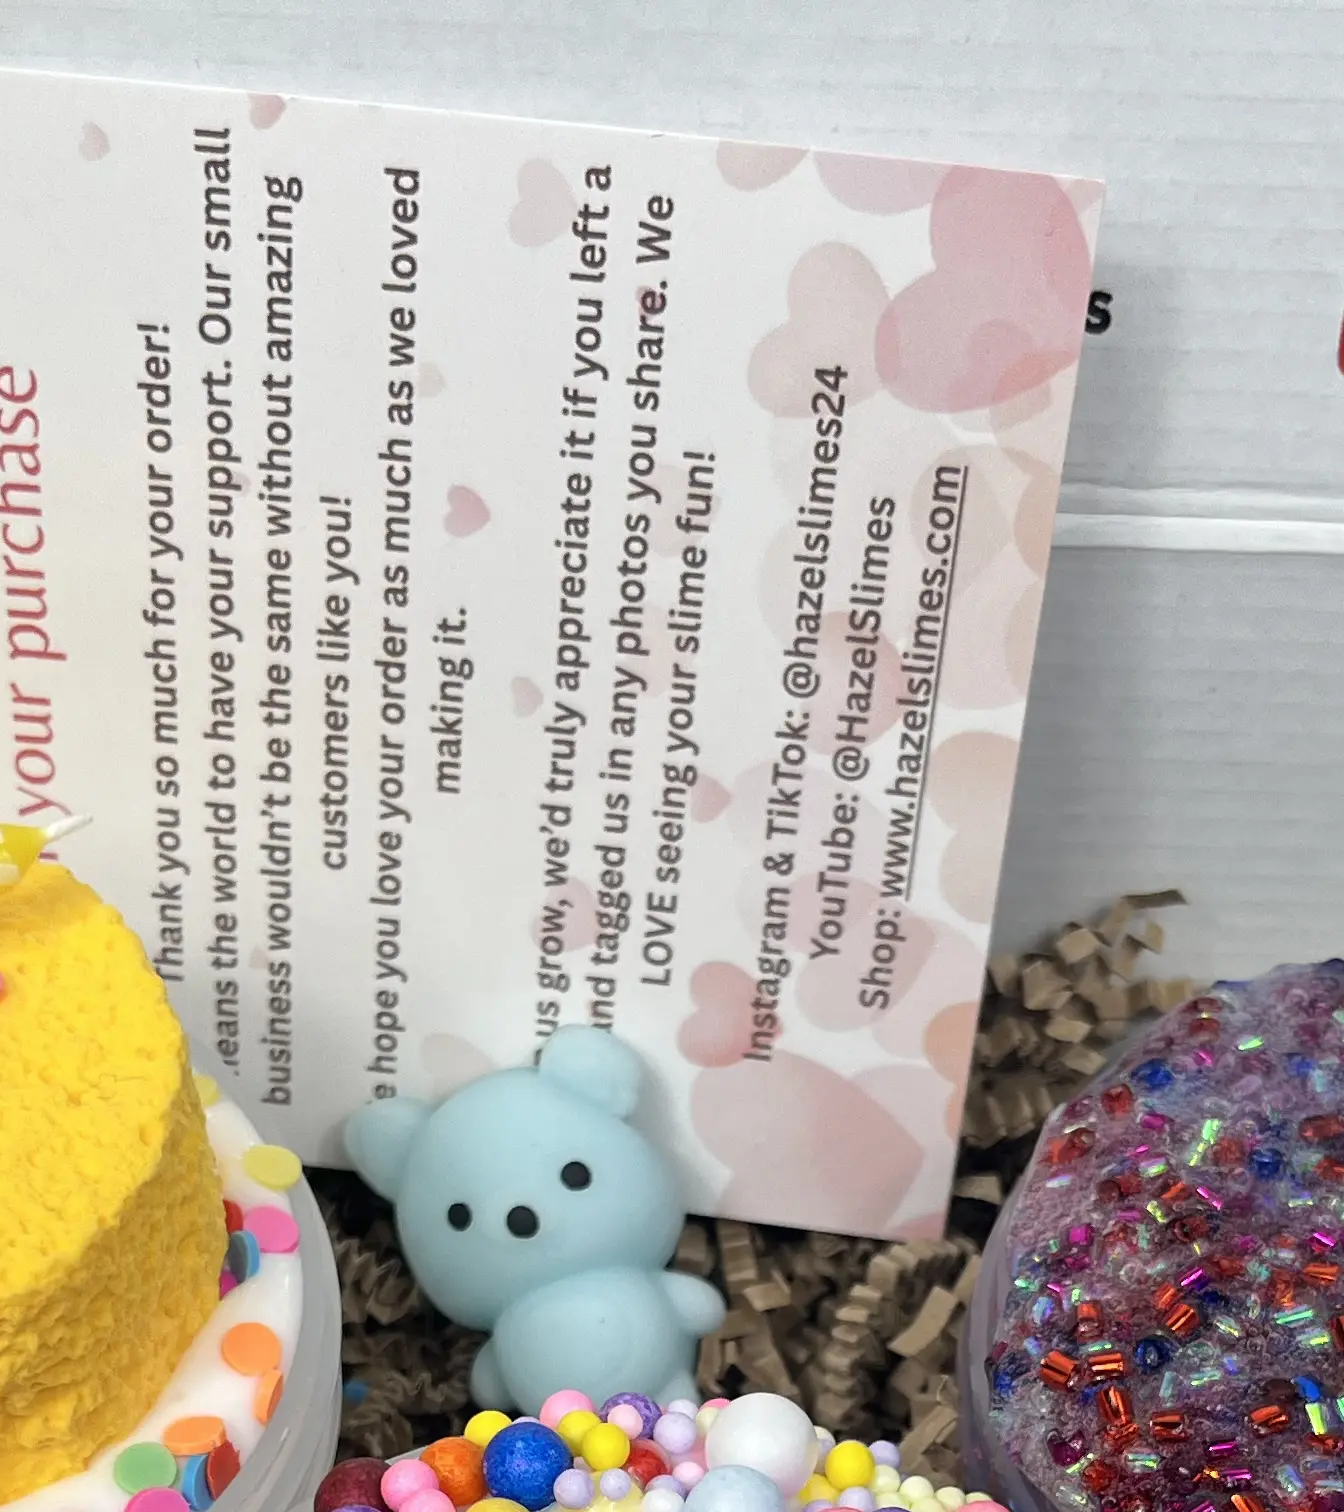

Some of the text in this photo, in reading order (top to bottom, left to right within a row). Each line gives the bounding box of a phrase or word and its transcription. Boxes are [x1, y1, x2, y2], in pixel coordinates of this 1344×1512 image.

[194, 127, 231, 252] small
[583, 164, 612, 192] a
[258, 175, 303, 362] amazing
[382, 167, 419, 293] loved
[569, 204, 609, 282] left
[636, 194, 675, 264] We
[199, 263, 231, 345] Our
[388, 307, 416, 366] we
[570, 298, 610, 381] you
[627, 280, 668, 412] share.
[385, 380, 413, 426] as
[560, 430, 595, 460] it
[562, 387, 598, 419] if
[201, 359, 241, 539] support.
[259, 374, 292, 537] without
[626, 424, 662, 505] you
[379, 439, 413, 553] much
[207, 549, 242, 642] your
[264, 549, 291, 652] same
[380, 565, 408, 608] as
[553, 473, 593, 692] appreciate
[608, 513, 652, 656] photos
[137, 323, 190, 982] Thank you so much for your order!
[204, 651, 235, 742] have
[260, 664, 291, 726] the
[317, 495, 359, 870] customers like you!
[375, 617, 408, 725] order
[430, 607, 474, 794] making it.
[608, 667, 648, 737] any
[641, 451, 715, 986] LOVE seeing your slime fun!
[743, 365, 849, 1062] Instagram & TikTok: @hazelslimes24
[809, 496, 896, 960] YouTube: @HazelSlimes
[858, 465, 968, 1010] Shop: www.hazelslimes.com
[9, 683, 71, 817] your
[205, 753, 235, 790] to
[260, 738, 291, 783] be
[376, 735, 411, 823] your
[544, 702, 587, 792] truly
[599, 748, 633, 781] in
[204, 801, 236, 903] world
[601, 793, 630, 833] us
[370, 831, 402, 906] love
[590, 845, 631, 965] tagged
[205, 913, 237, 969] the
[371, 918, 407, 982] you
[534, 899, 573, 993] grow,
[260, 962, 292, 1105] business
[366, 991, 404, 1073] hope
[533, 1000, 558, 1037] us
